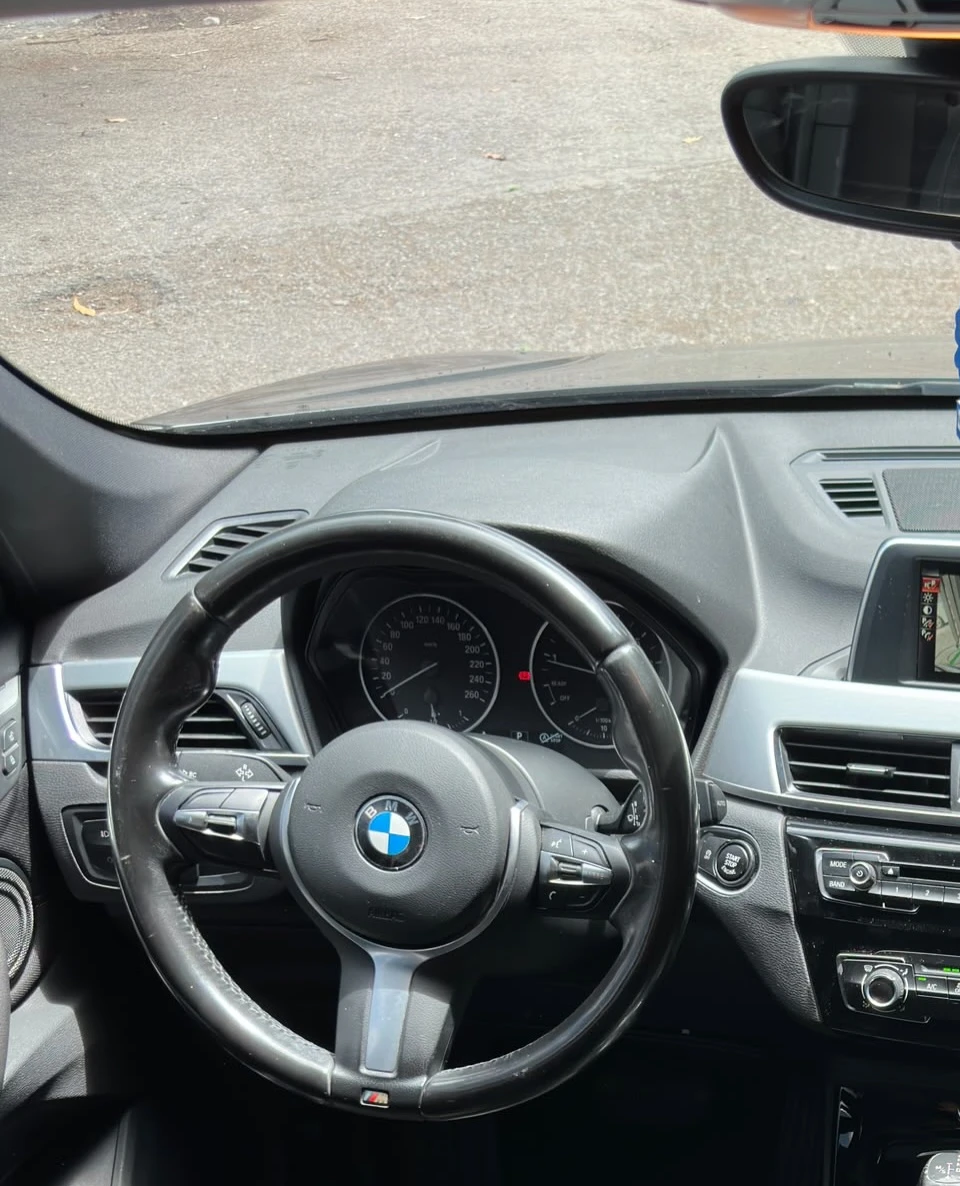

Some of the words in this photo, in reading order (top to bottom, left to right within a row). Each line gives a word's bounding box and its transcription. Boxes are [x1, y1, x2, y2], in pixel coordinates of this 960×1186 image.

[416, 615, 429, 624] 120
[432, 616, 445, 625] 140
[401, 621, 414, 629] 100
[447, 622, 460, 631] 160
[390, 631, 400, 639] 80
[458, 633, 472, 641] 180
[382, 642, 393, 651] 60
[464, 645, 480, 654] 200
[380, 657, 390, 665] 40
[469, 660, 485, 669] 220
[381, 672, 391, 680] 20
[469, 675, 484, 684] 240
[464, 690, 480, 699] 260
[516, 731, 523, 739] P
[364, 800, 419, 826] BMW
[725, 853, 741, 863] START
[724, 859, 738, 868] STOP
[830, 860, 847, 869] MODE
[829, 880, 845, 888] BAND
[926, 983, 938, 991] A/C
